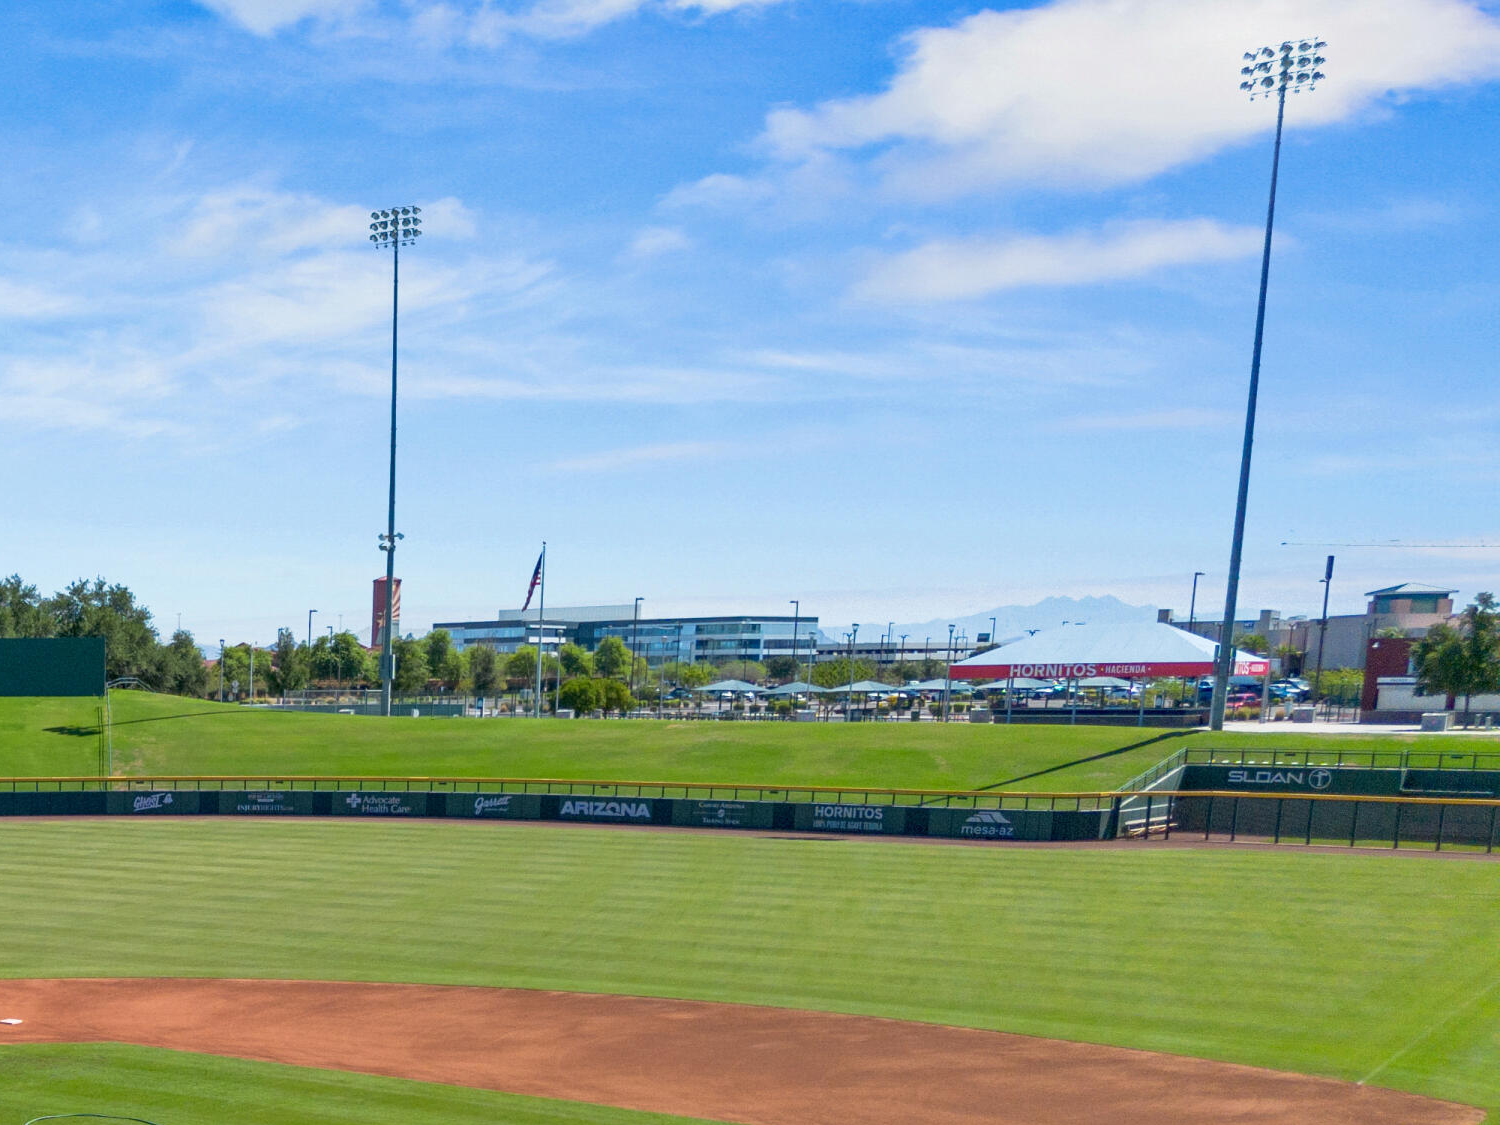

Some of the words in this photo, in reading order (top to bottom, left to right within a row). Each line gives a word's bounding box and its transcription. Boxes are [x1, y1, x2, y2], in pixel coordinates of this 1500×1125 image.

[1009, 663, 1097, 677] HORNITOS
[1105, 664, 1146, 674] HACIENDA
[1228, 770, 1303, 784] SLOAN
[362, 796, 401, 805] Advocate
[362, 804, 389, 813] Health
[391, 805, 411, 813] Care
[560, 801, 650, 817] ARIZONA
[814, 806, 884, 819] HORNITOS
